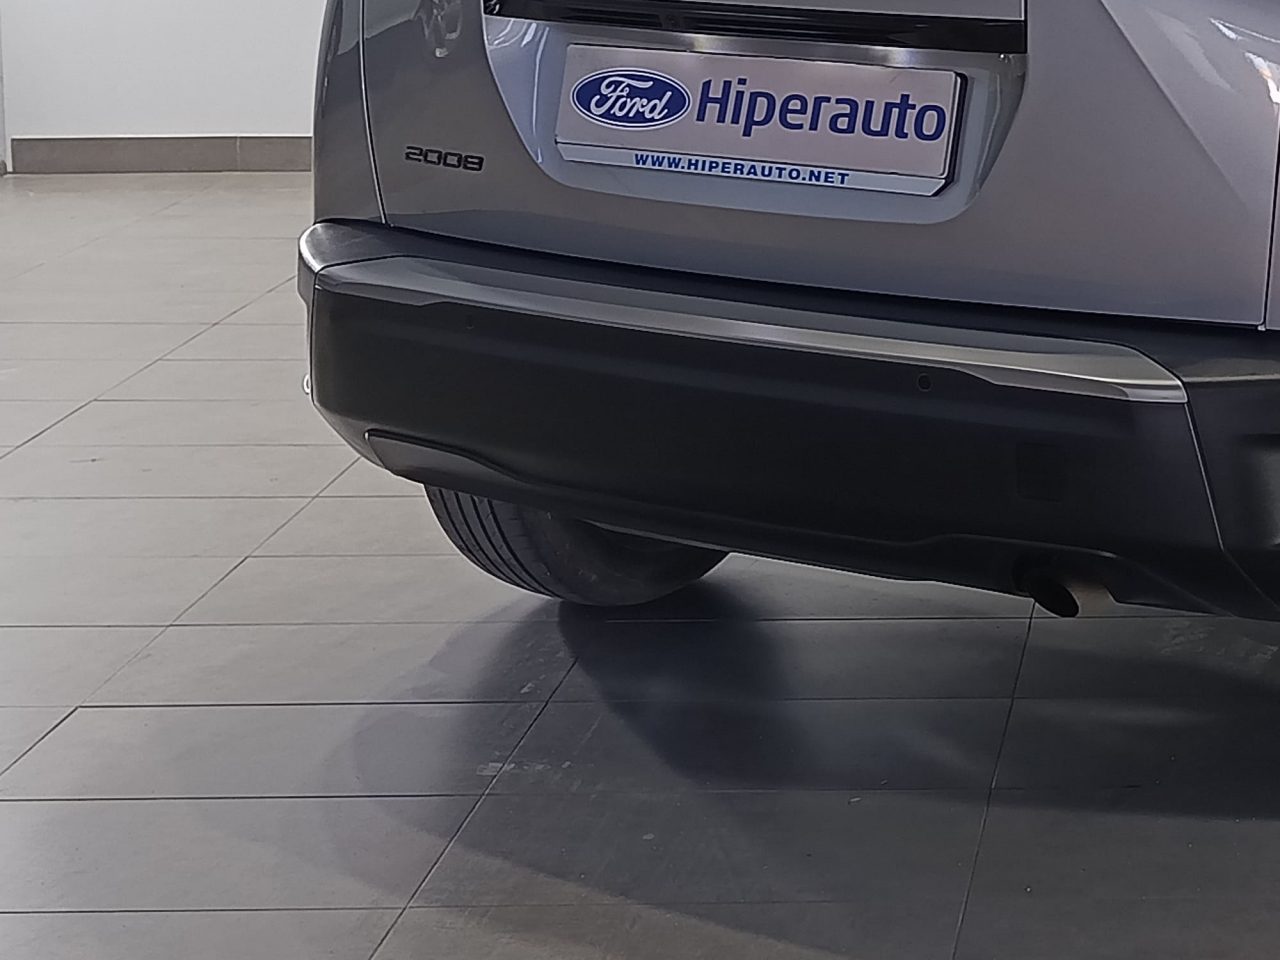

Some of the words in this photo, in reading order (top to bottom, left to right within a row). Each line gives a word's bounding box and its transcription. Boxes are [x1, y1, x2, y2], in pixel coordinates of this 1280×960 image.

[590, 74, 670, 121] Ford
[695, 77, 947, 142] Hiperauto
[404, 145, 485, 172] 2008
[634, 152, 850, 185] WWW.HIPERAUTO.NET
